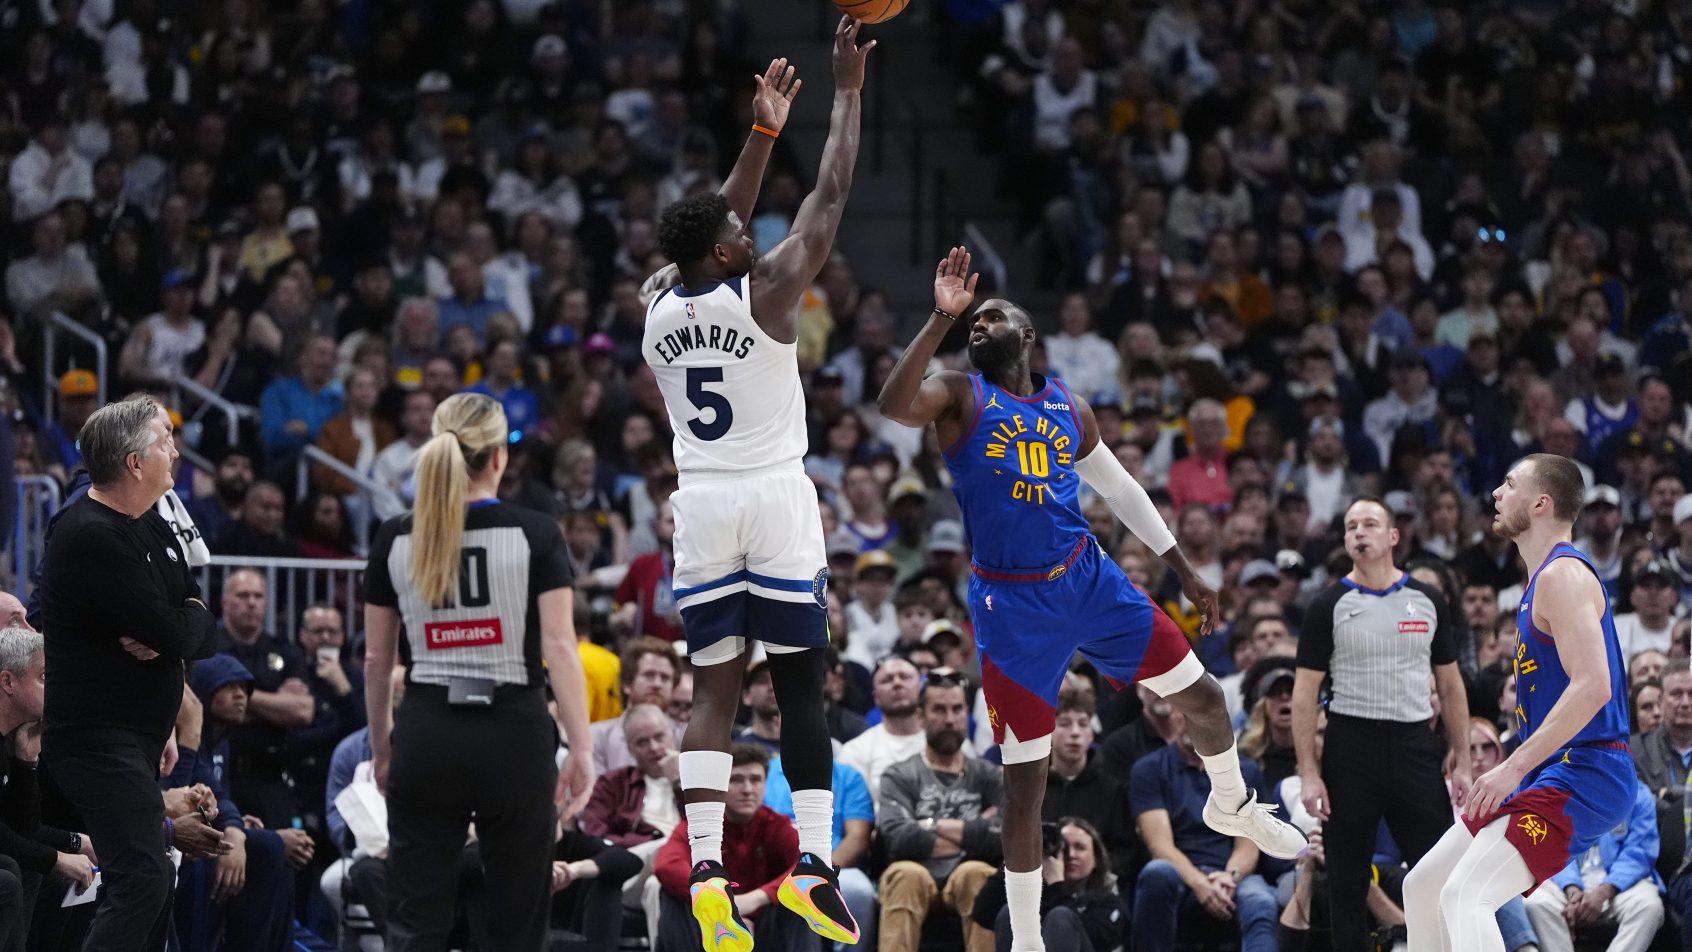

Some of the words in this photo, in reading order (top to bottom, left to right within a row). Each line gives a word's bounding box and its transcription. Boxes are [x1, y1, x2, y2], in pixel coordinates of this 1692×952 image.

[654, 324, 755, 365] EDWARDS
[686, 366, 733, 441] 5
[985, 414, 1028, 458] MILE
[1036, 416, 1072, 464] HIGH
[1016, 440, 1049, 478] 10
[431, 626, 496, 644] Emirates
